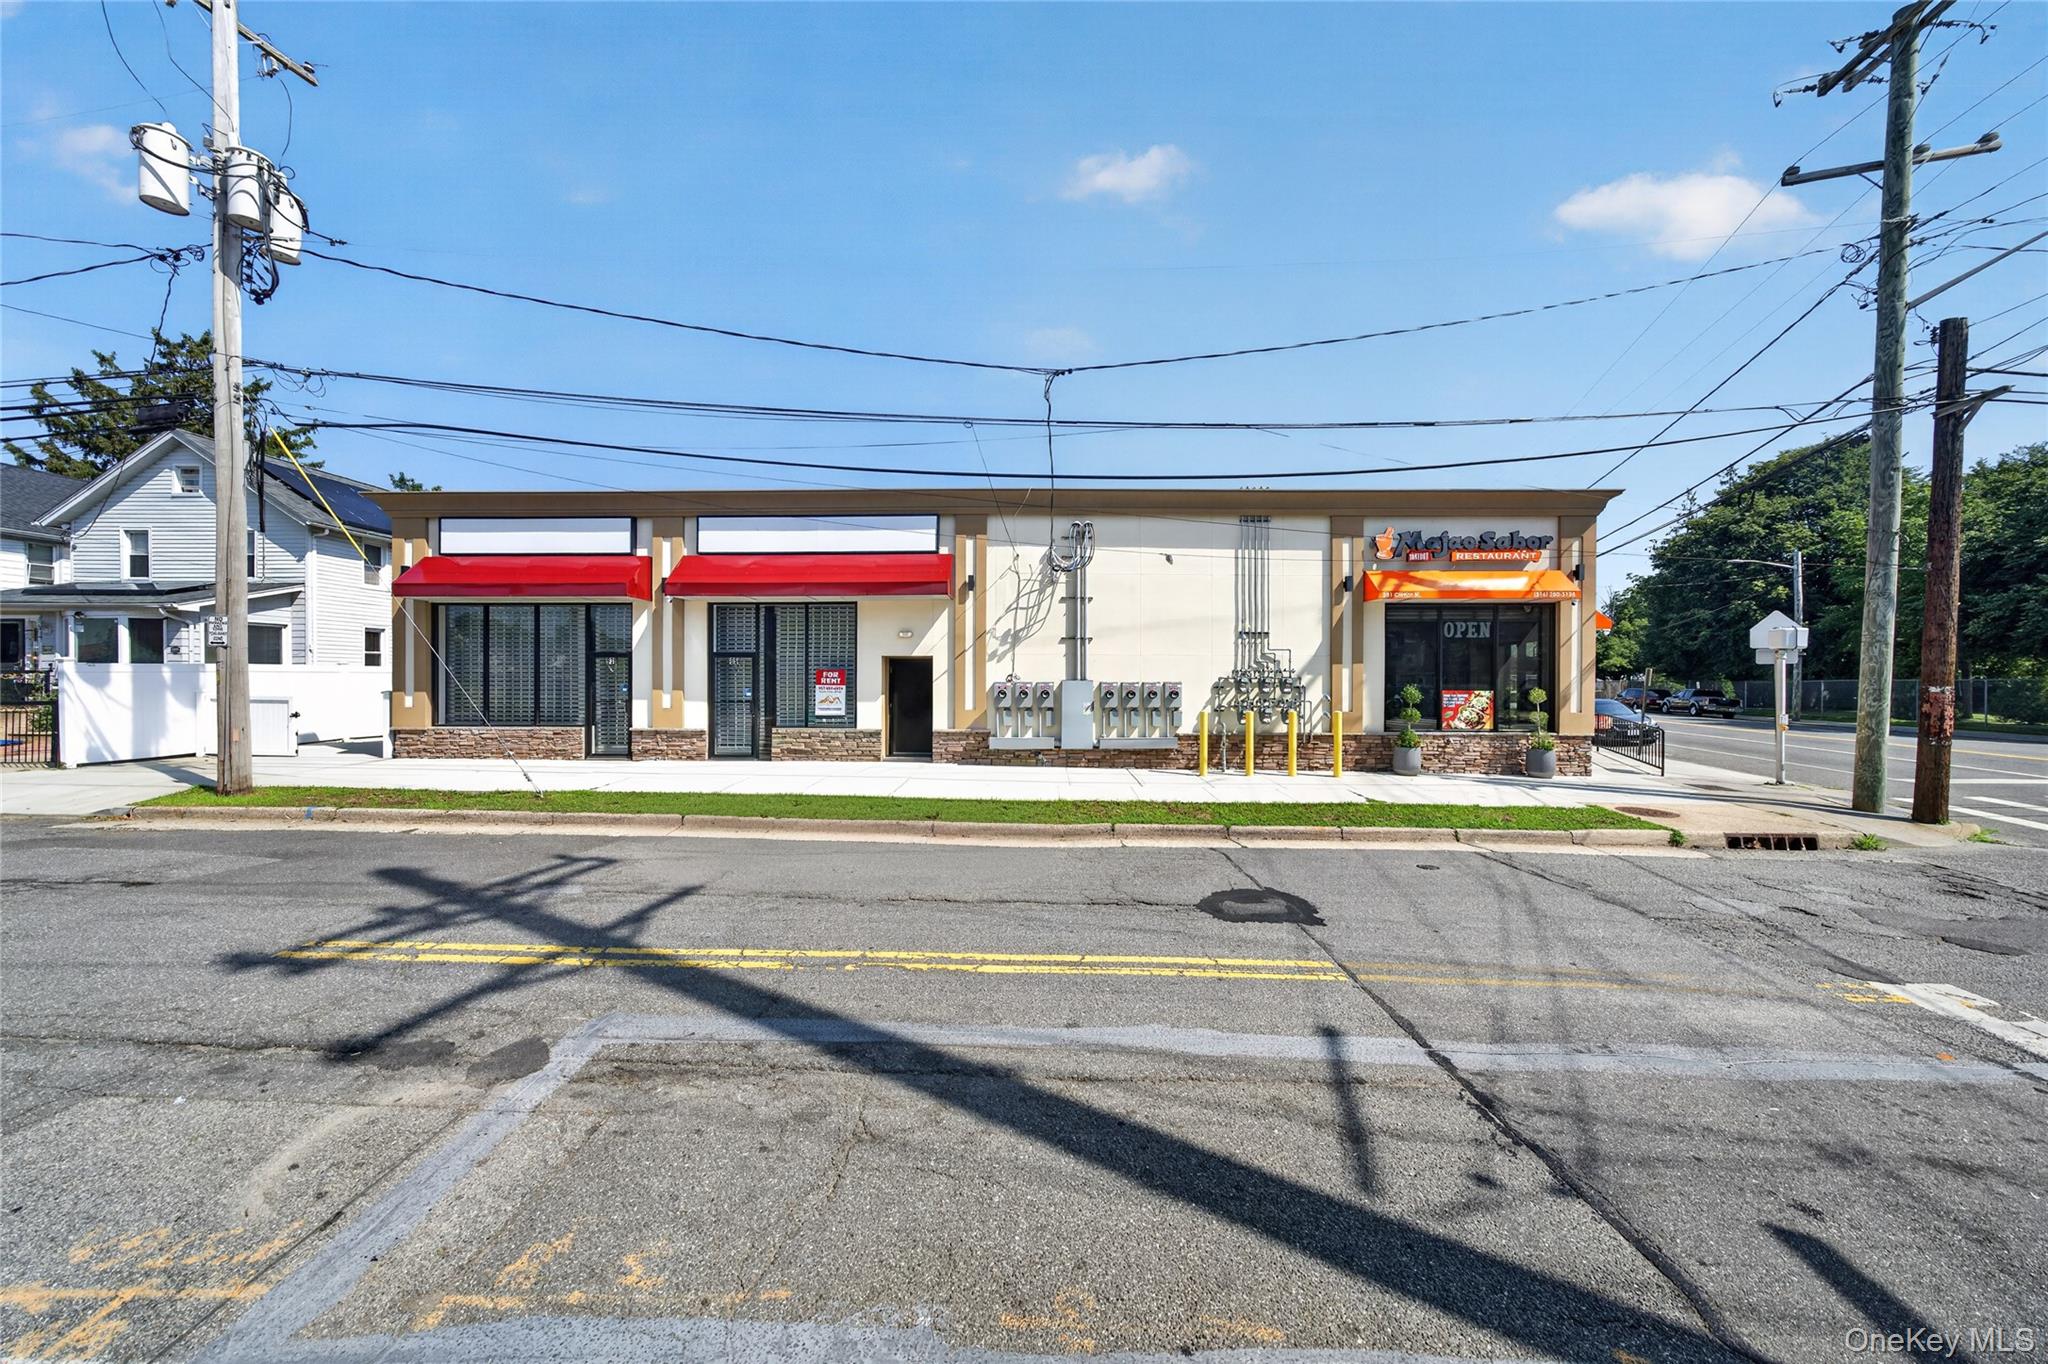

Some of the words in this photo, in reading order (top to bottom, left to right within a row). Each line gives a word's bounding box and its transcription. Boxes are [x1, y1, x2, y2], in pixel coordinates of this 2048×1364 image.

[1478, 530, 1553, 550] Sabor
[1456, 551, 1536, 560] RESTAURANT
[1443, 621, 1491, 638] OPEN
